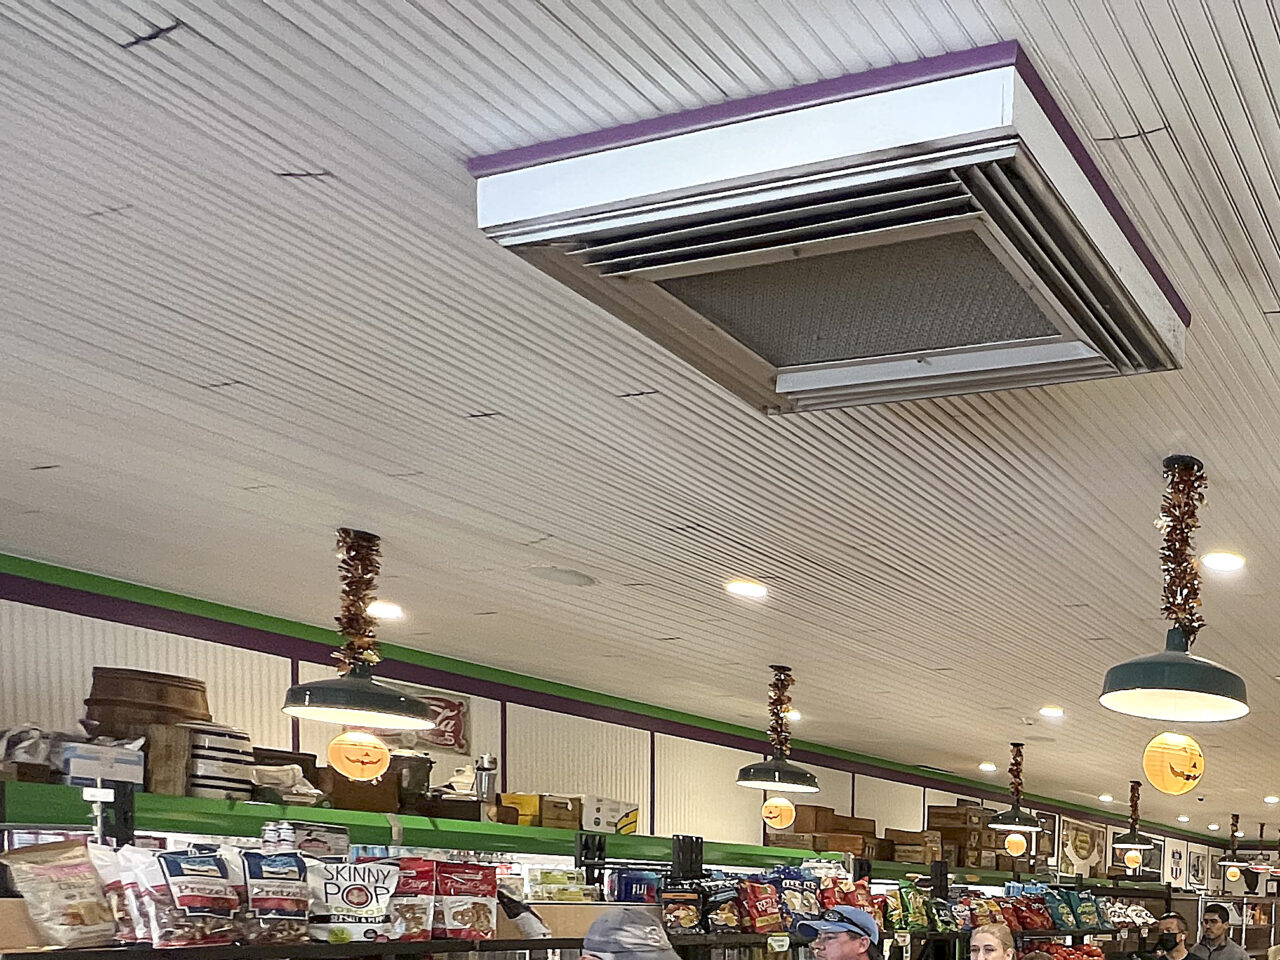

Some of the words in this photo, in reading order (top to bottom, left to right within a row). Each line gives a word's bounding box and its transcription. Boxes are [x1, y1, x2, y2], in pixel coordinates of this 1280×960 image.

[323, 865, 391, 885] SKINNY
[324, 881, 390, 909] POP
[632, 883, 648, 895] FIJI
